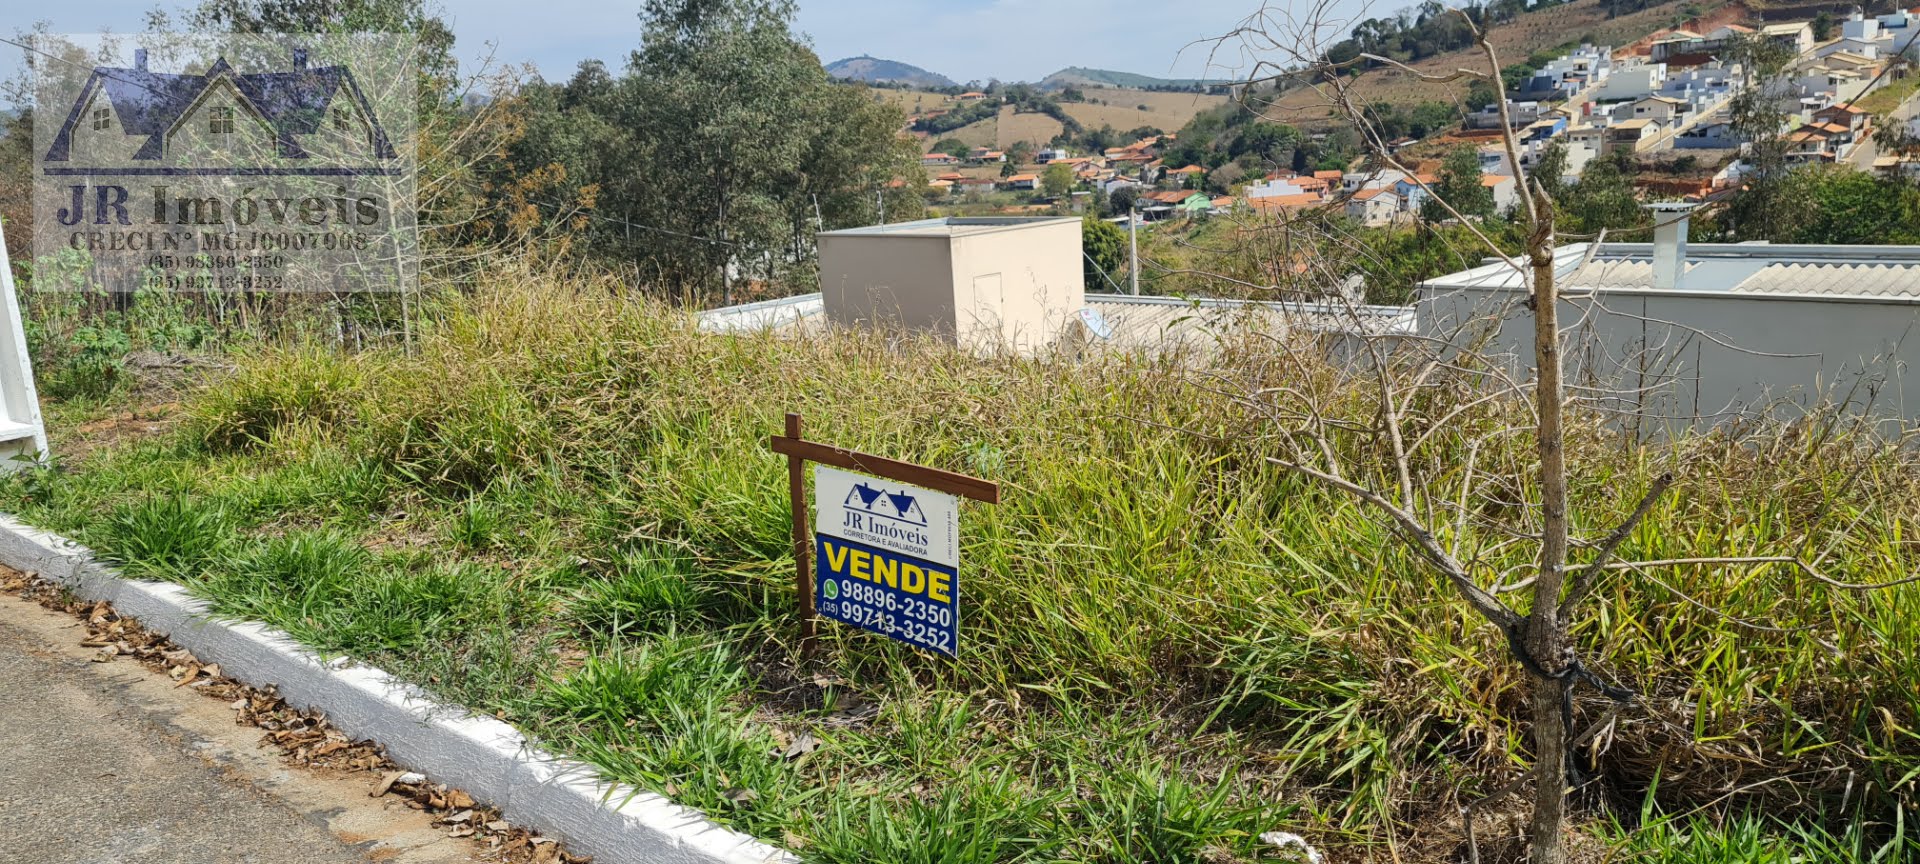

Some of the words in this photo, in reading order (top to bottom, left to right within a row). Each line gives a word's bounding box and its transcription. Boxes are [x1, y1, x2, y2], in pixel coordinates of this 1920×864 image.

[843, 510, 863, 531] JR
[868, 516, 928, 546] Imóveis
[843, 528, 881, 544] CORRETORA
[882, 538, 887, 546] E
[887, 540, 928, 556] AVALIADORA
[823, 542, 951, 604] VENDE
[822, 601, 838, 615] (35)
[841, 600, 950, 650] 99713-3252
[841, 579, 951, 627] 98896-2350
